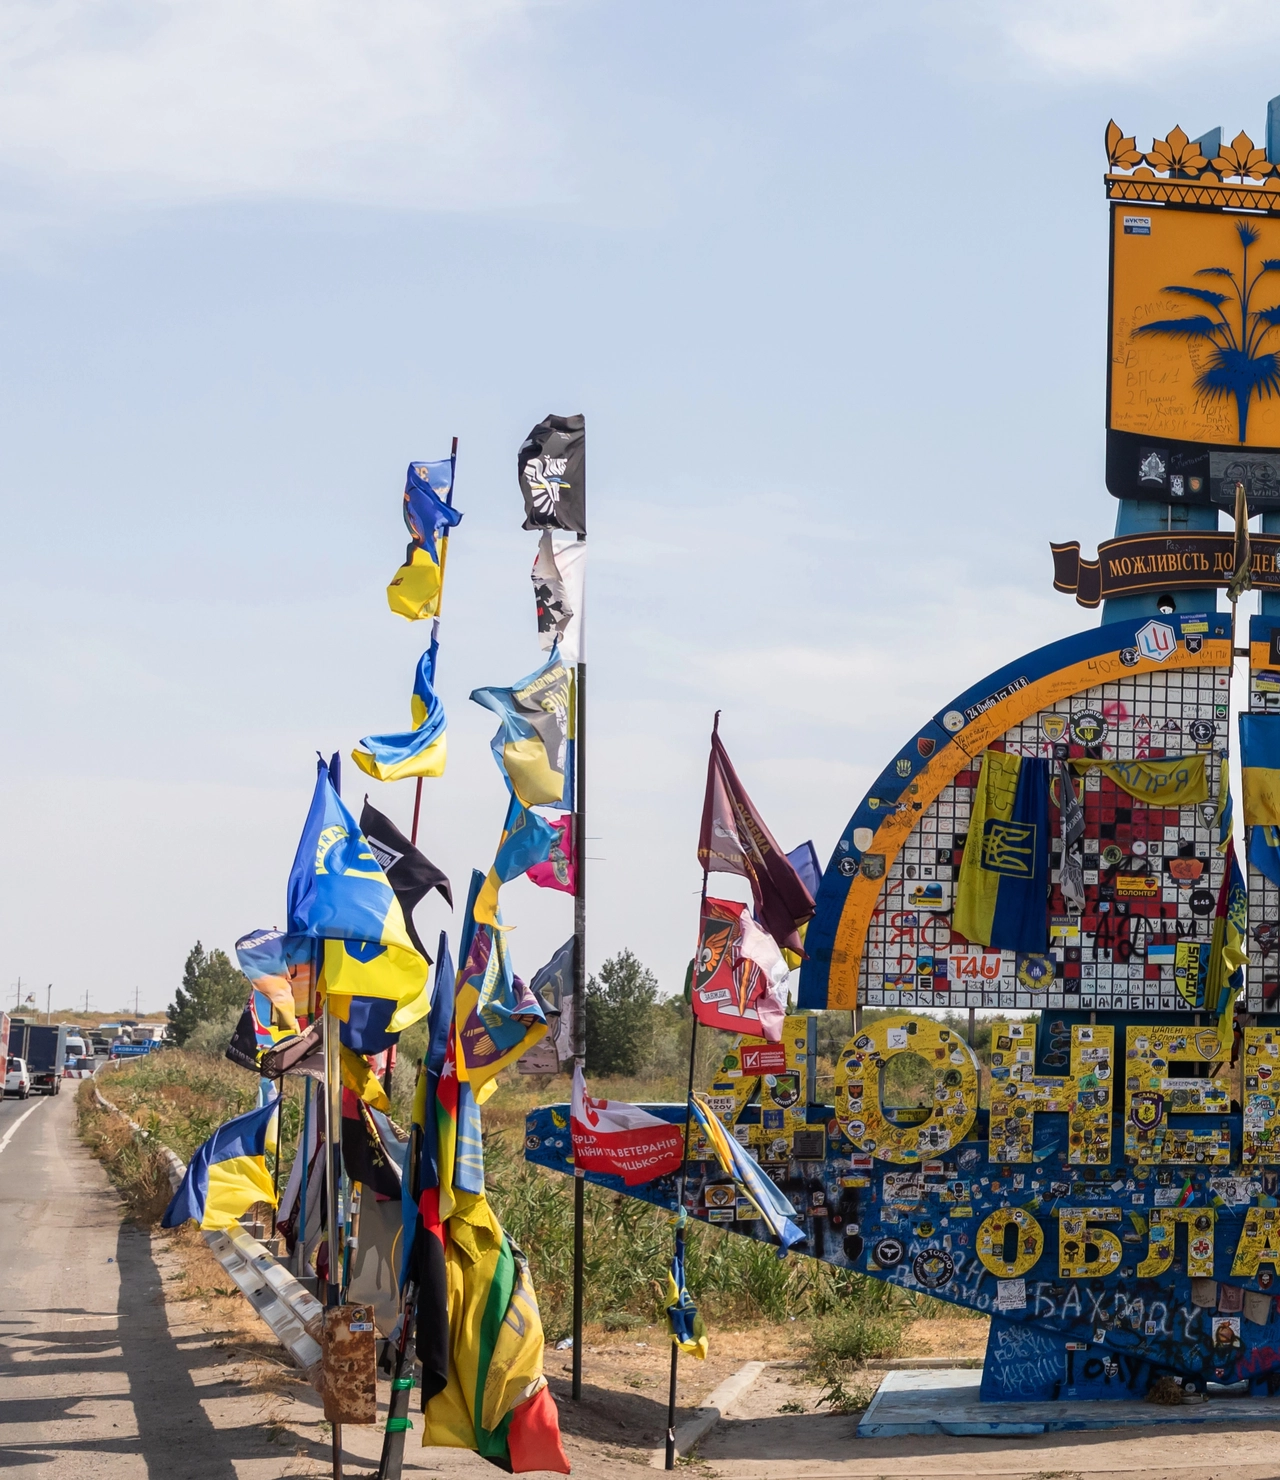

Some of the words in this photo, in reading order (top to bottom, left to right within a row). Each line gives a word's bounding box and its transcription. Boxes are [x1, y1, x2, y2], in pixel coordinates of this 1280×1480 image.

[1109, 553, 1209, 578] МОЖЛИВІСТЬ
[966, 709, 978, 719] 24
[1074, 709, 1104, 720] ВОЛОНТЕР
[737, 802, 770, 856] ОКРЕМА
[1118, 889, 1157, 897] ВОЛОНТЕР
[949, 955, 1002, 979] T4U
[1185, 946, 1200, 998] VIRTUS
[617, 1137, 678, 1158] ВЕТЕРАНІВ
